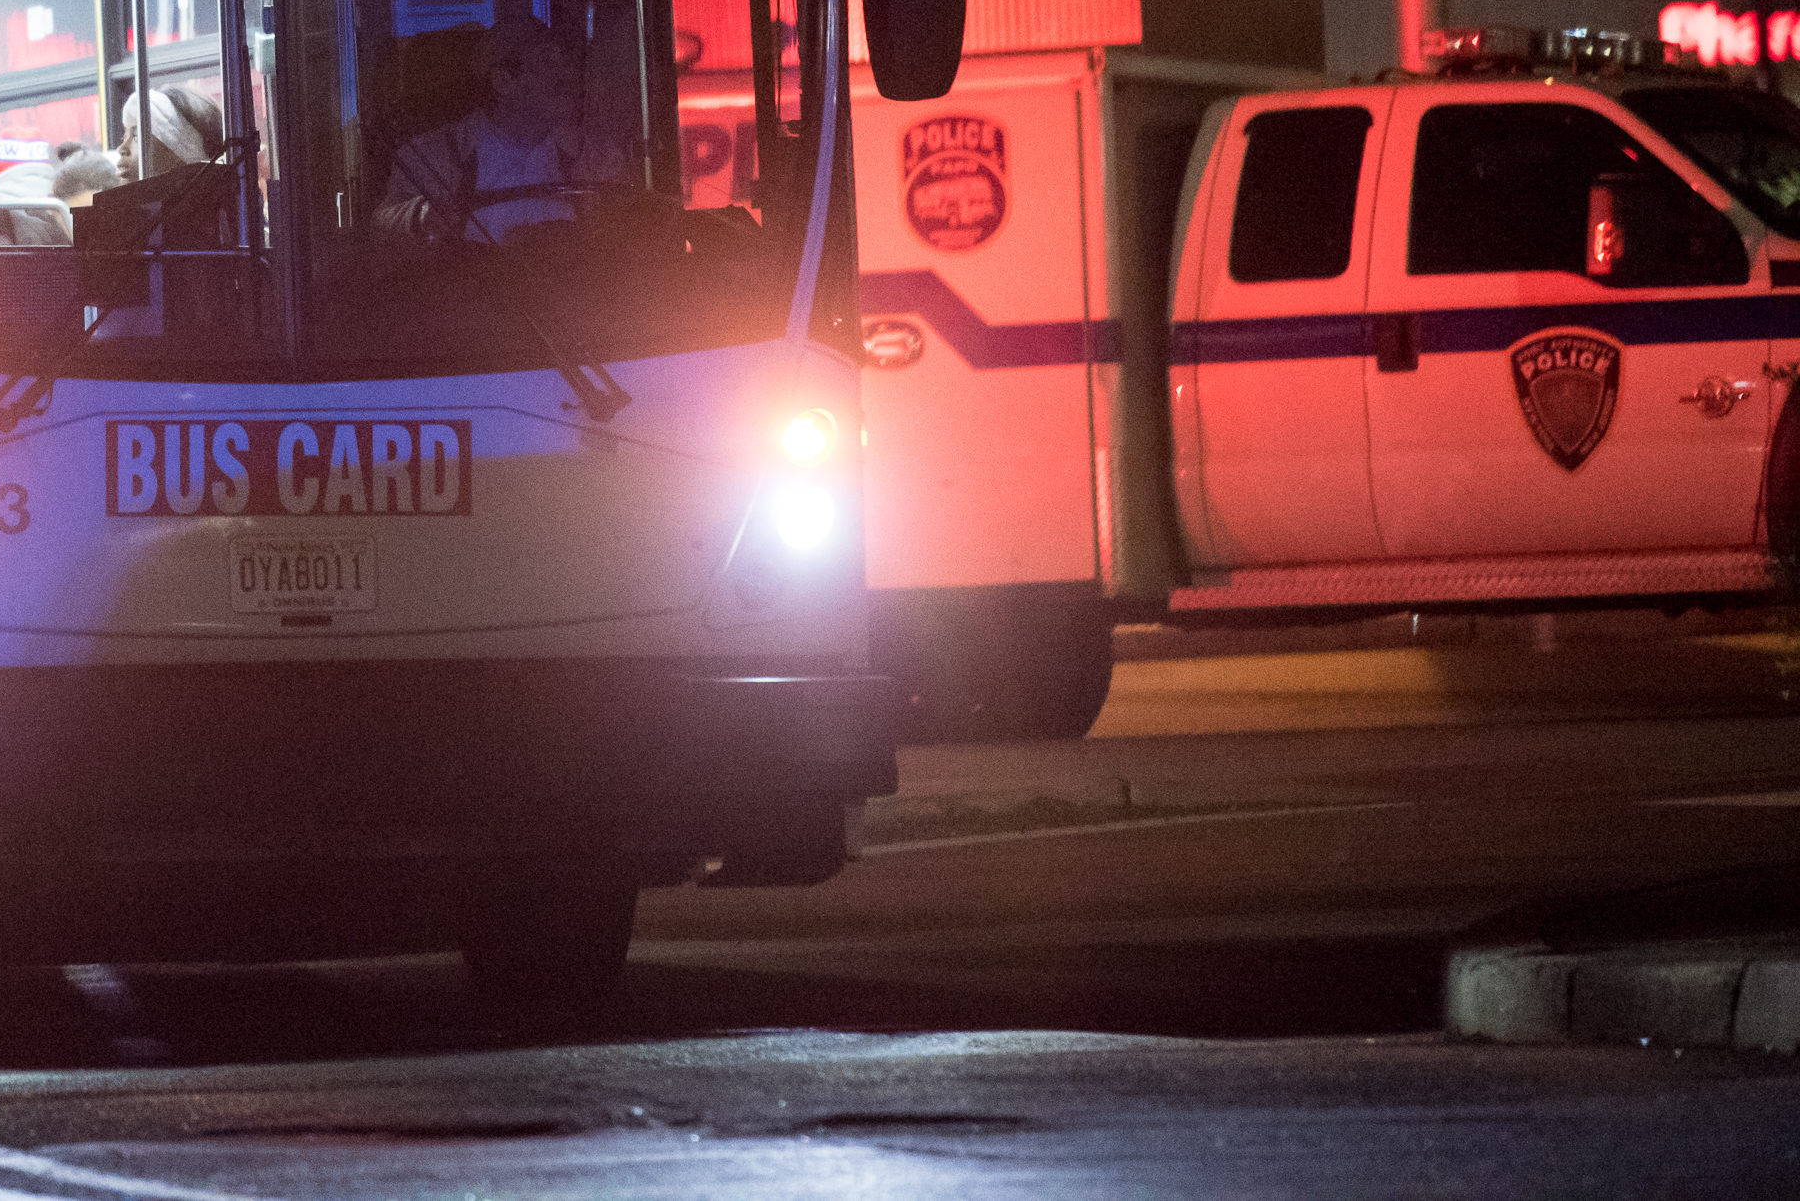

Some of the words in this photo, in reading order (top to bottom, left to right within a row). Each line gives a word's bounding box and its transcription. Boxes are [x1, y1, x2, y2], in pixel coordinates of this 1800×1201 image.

[910, 121, 997, 156] POLICE
[1520, 349, 1611, 380] POLICE
[117, 422, 250, 514] BUS
[277, 422, 460, 514] CARD
